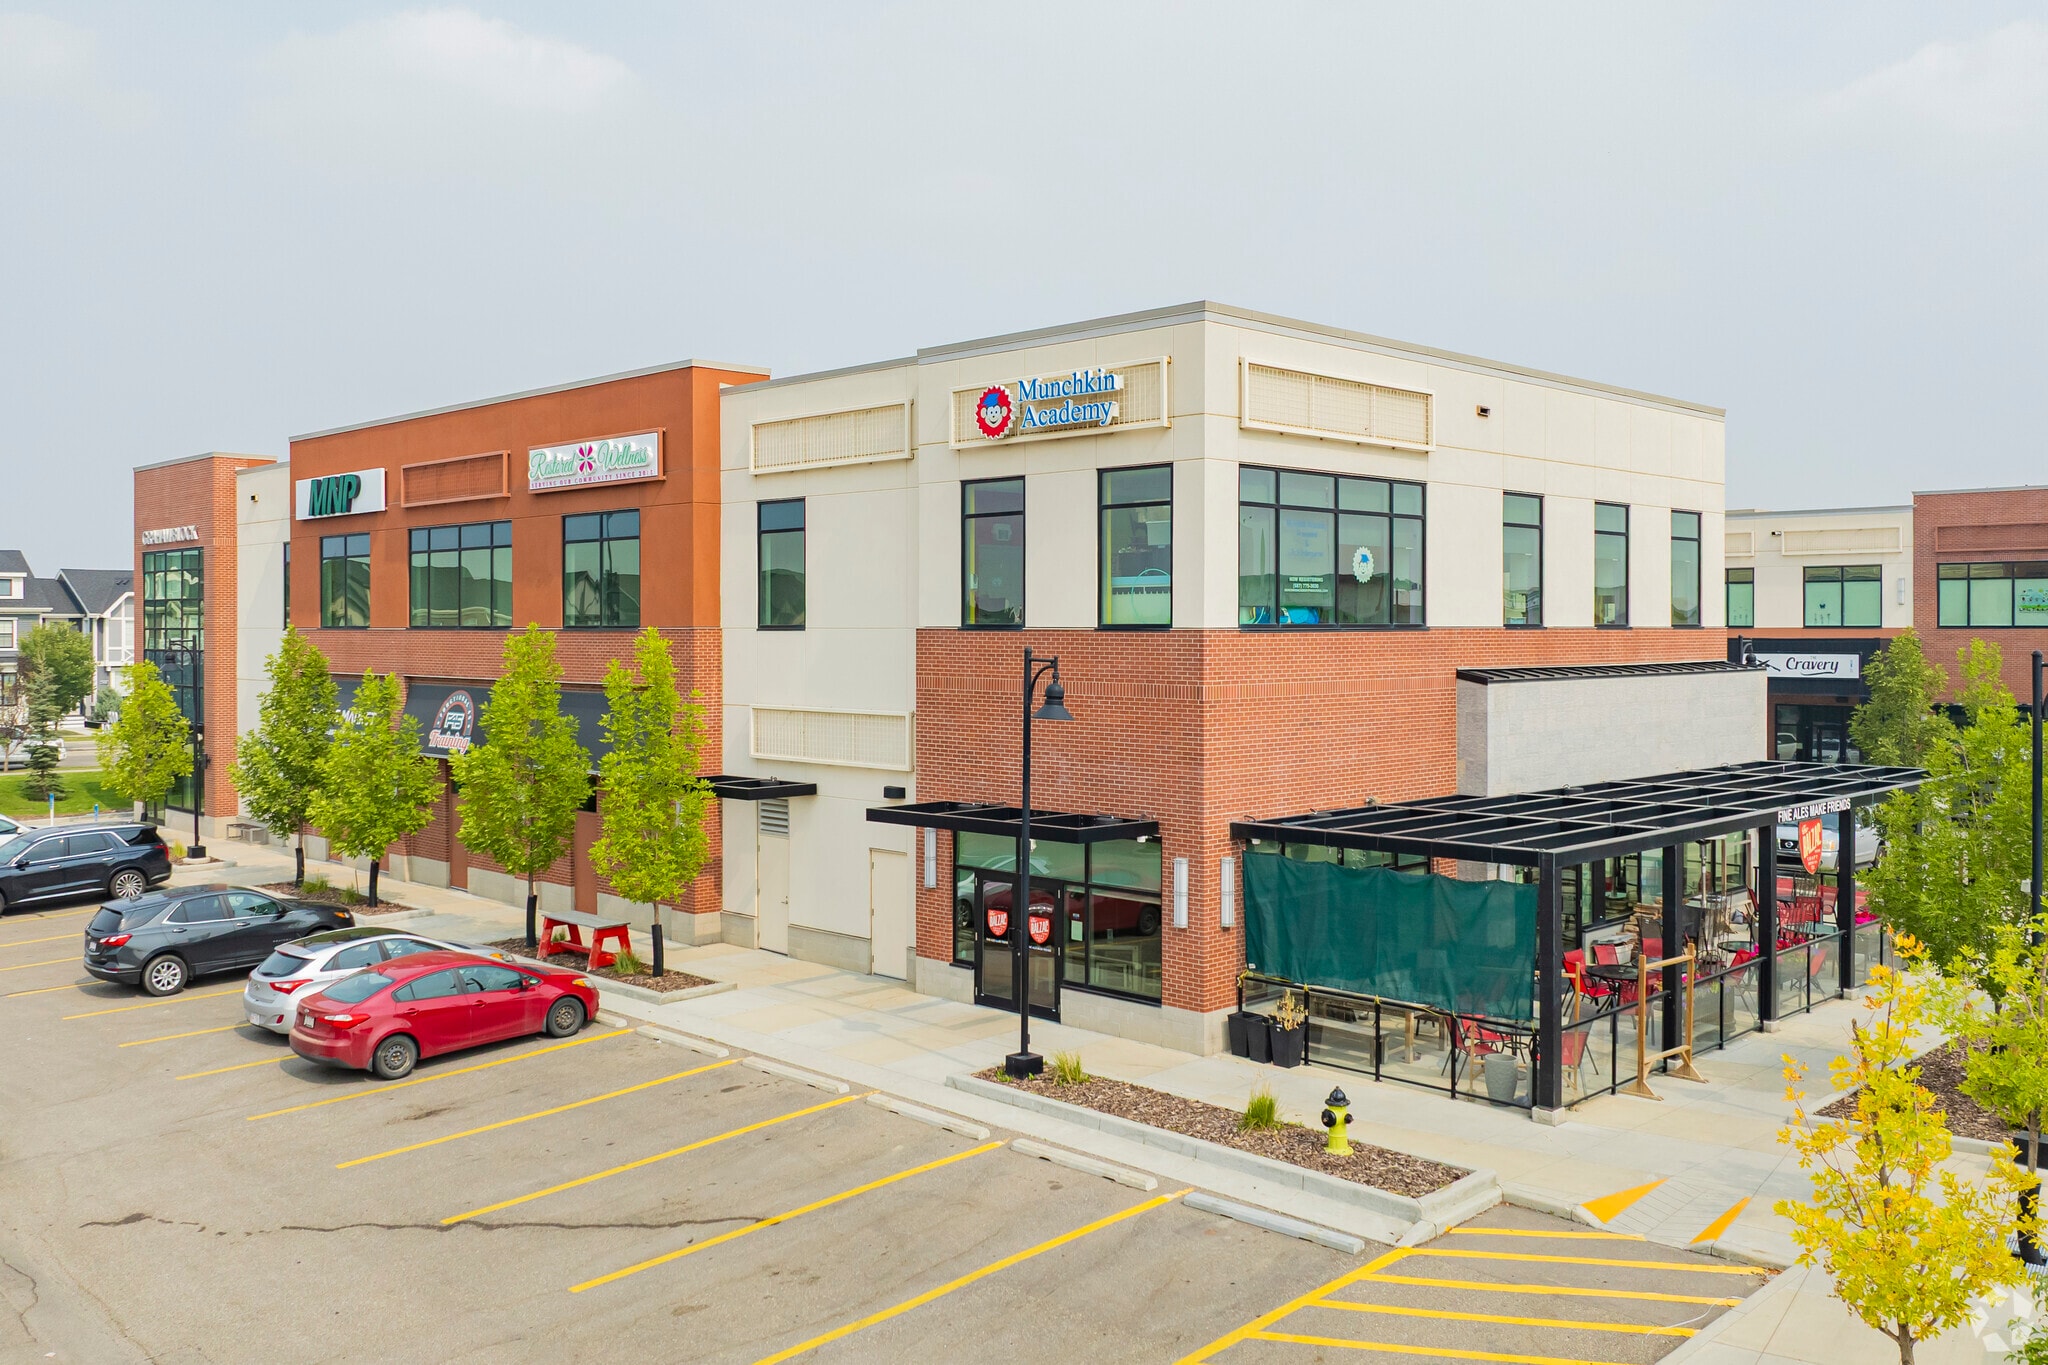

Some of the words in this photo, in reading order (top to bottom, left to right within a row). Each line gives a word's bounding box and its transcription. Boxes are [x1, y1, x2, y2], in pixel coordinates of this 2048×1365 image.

[1018, 367, 1117, 402] Munchkin
[1021, 399, 1113, 429] Academy
[529, 450, 577, 480] Restored
[597, 440, 649, 471] Wellness
[574, 474, 612, 484] COMMUNITY
[615, 471, 635, 479] SINCE
[308, 474, 361, 516] MNP
[1786, 656, 1839, 675] Cravery
[428, 728, 471, 755] Training
[1777, 808, 1793, 823] FINE
[1793, 805, 1809, 820] ALES
[1809, 802, 1827, 816] MAKE
[1827, 798, 1851, 814] FRIENDS
